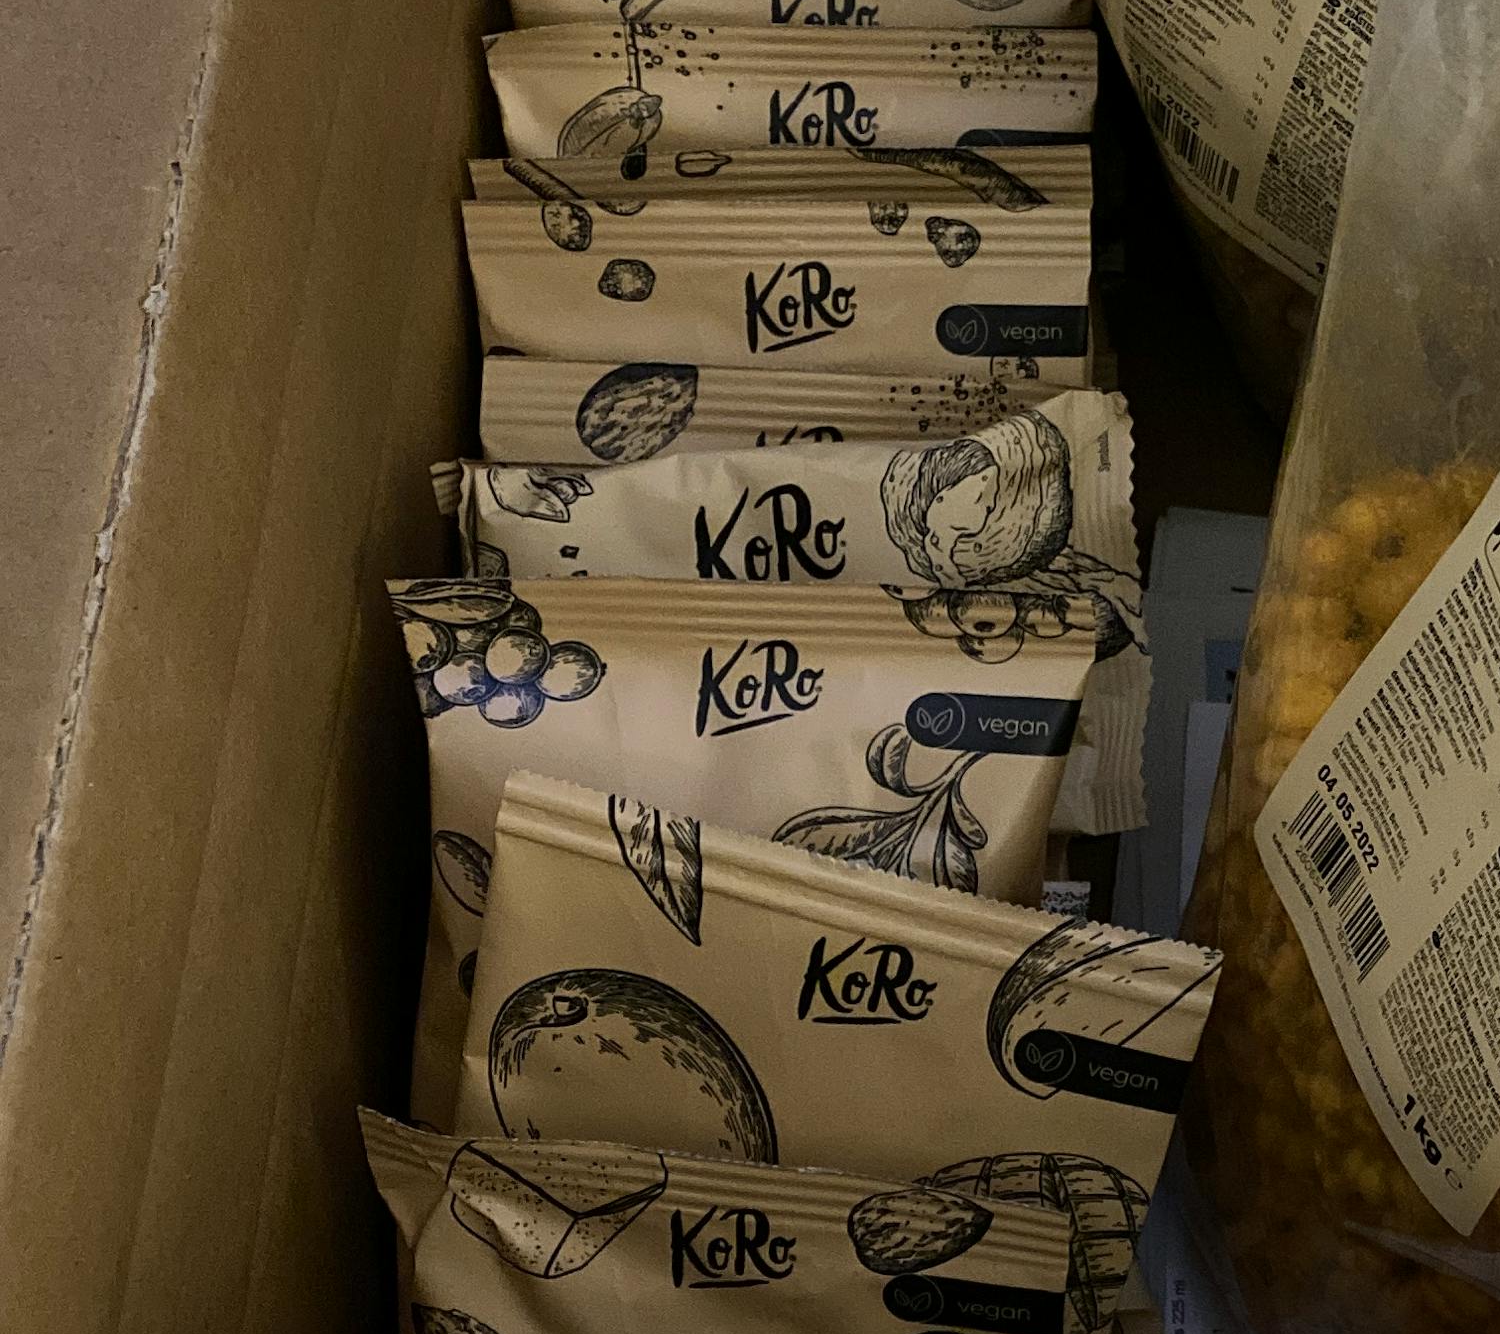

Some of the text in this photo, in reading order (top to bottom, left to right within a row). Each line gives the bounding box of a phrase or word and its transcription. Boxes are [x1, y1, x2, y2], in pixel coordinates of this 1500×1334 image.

[769, 81, 879, 147] KoRo
[745, 261, 1065, 353] KoRo vegan
[695, 483, 847, 581] KoRo
[696, 639, 1051, 741] KoRo vegan
[1318, 764, 1379, 873] 04.05.2022
[798, 937, 1160, 1094] KoRo vegan
[1413, 1115, 1442, 1166] kg
[671, 1207, 1033, 1324] KoRo vegan
